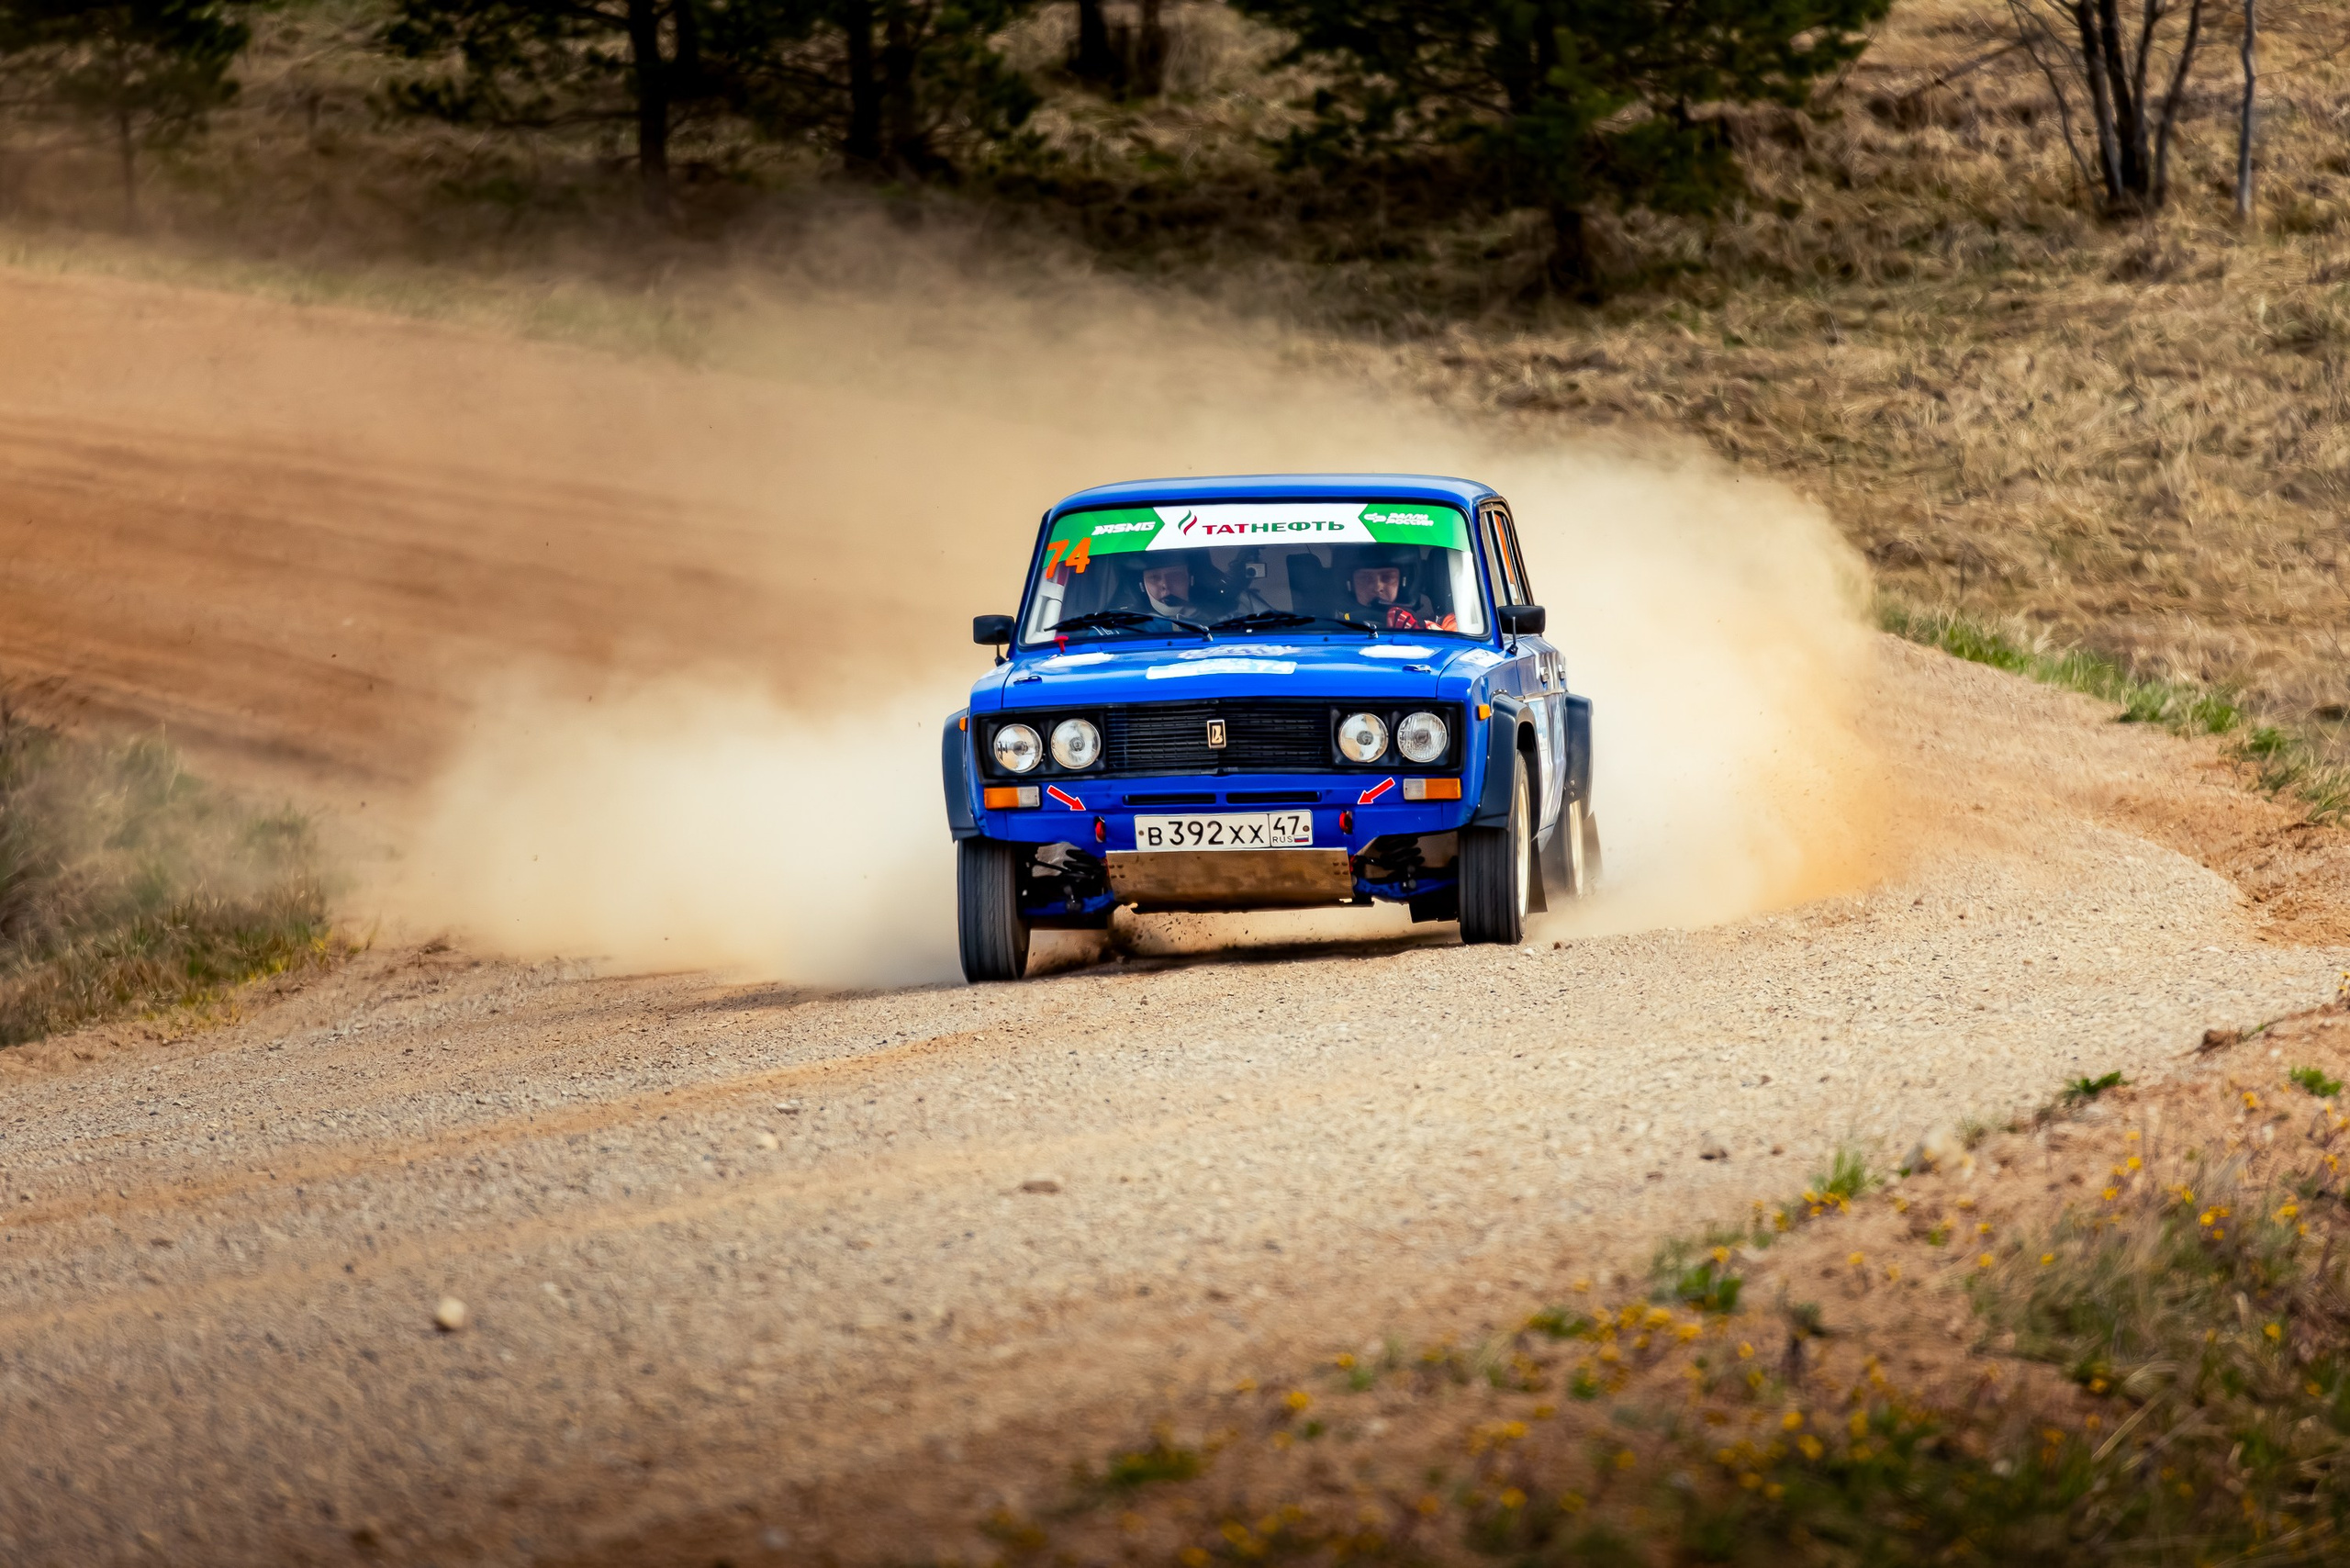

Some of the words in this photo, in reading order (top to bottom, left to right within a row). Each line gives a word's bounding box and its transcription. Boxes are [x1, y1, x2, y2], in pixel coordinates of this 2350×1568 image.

[1202, 521, 1345, 535] ТАТНЕФТЬ
[1045, 537, 1091, 580] 74
[1273, 815, 1300, 835] 47
